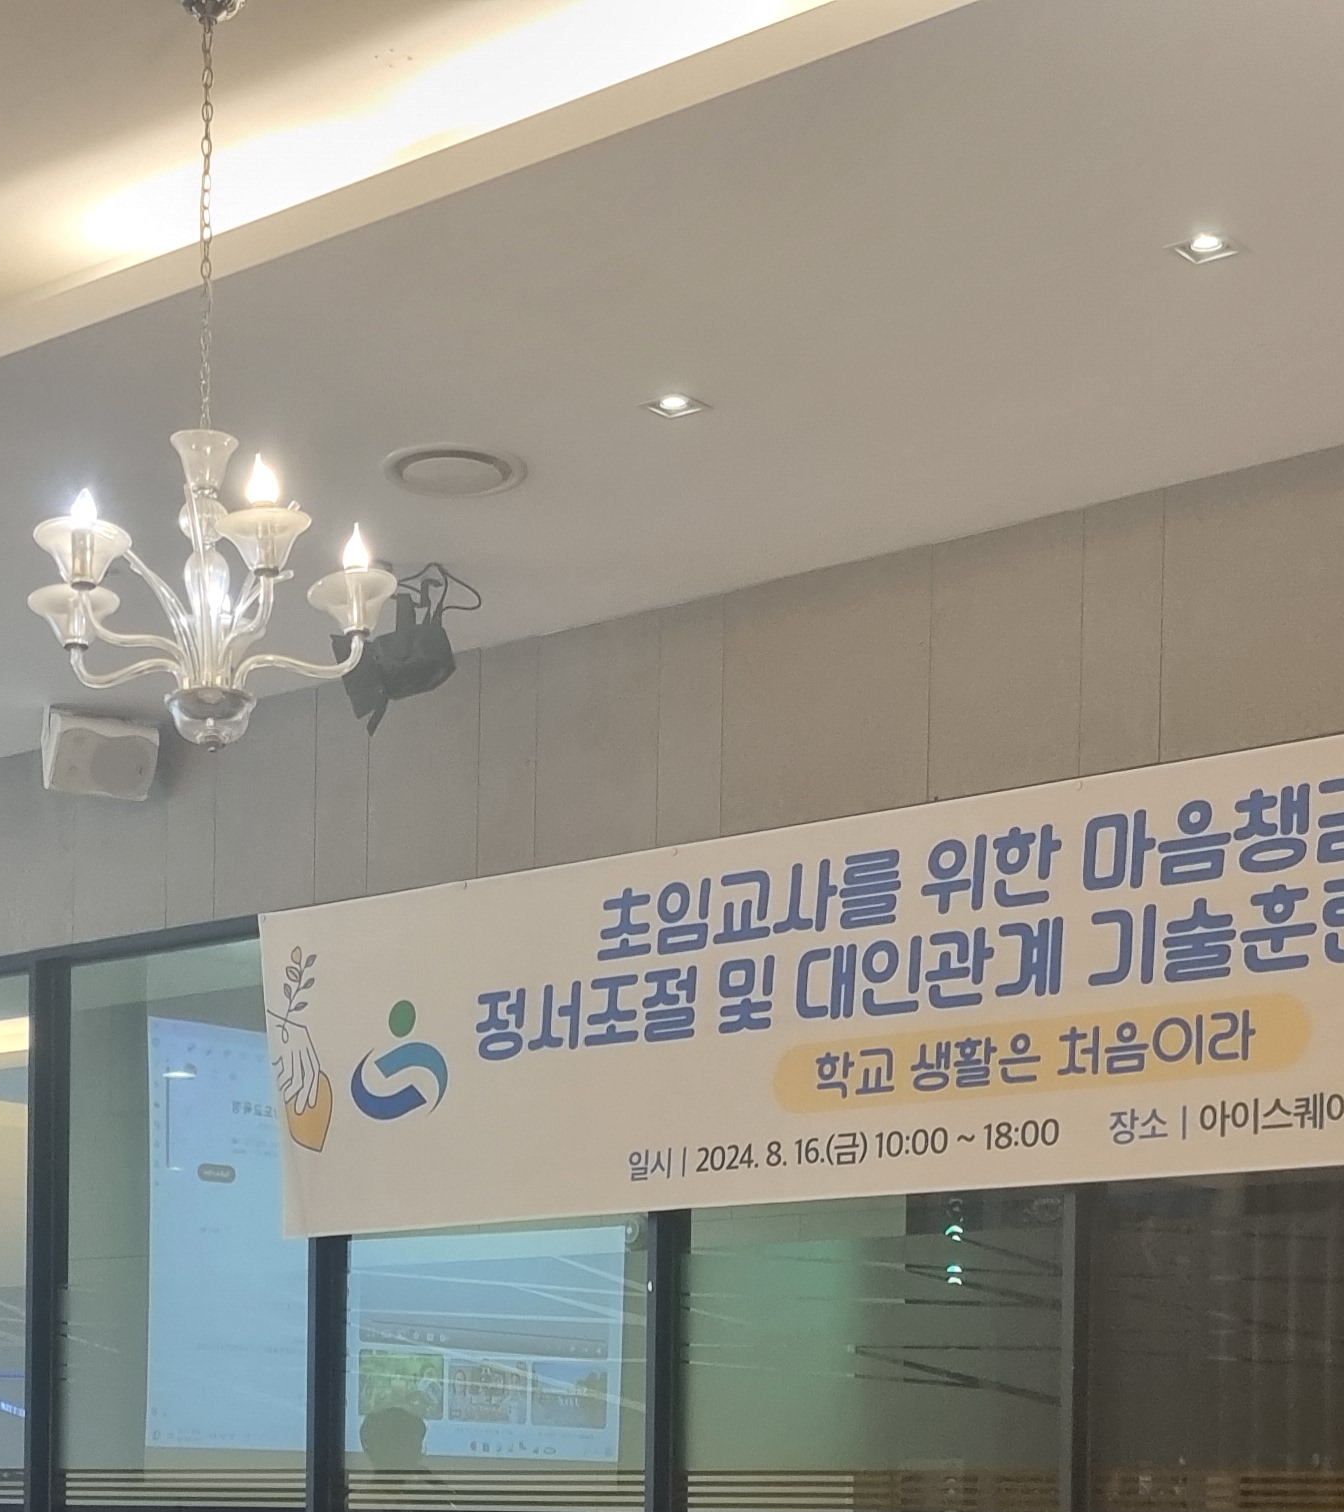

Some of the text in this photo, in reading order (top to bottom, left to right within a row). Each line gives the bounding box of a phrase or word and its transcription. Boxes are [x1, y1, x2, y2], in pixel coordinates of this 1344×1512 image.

[597, 849, 901, 961] 초임교사를
[921, 824, 1062, 914] 위한
[476, 965, 697, 1060] 정서조절
[718, 956, 775, 1034] 및
[796, 916, 1063, 1020] 대인관계
[816, 1010, 1256, 1099] 학교 생활은 처음이라
[629, 1149, 672, 1182] 일시
[695, 1143, 759, 1173] 2024.
[766, 1141, 787, 1167] 8.
[794, 1131, 868, 1166] 16.(금)
[875, 1127, 948, 1159] 10:00
[983, 1118, 1060, 1151] 18:00
[1109, 1108, 1168, 1144] 장소
